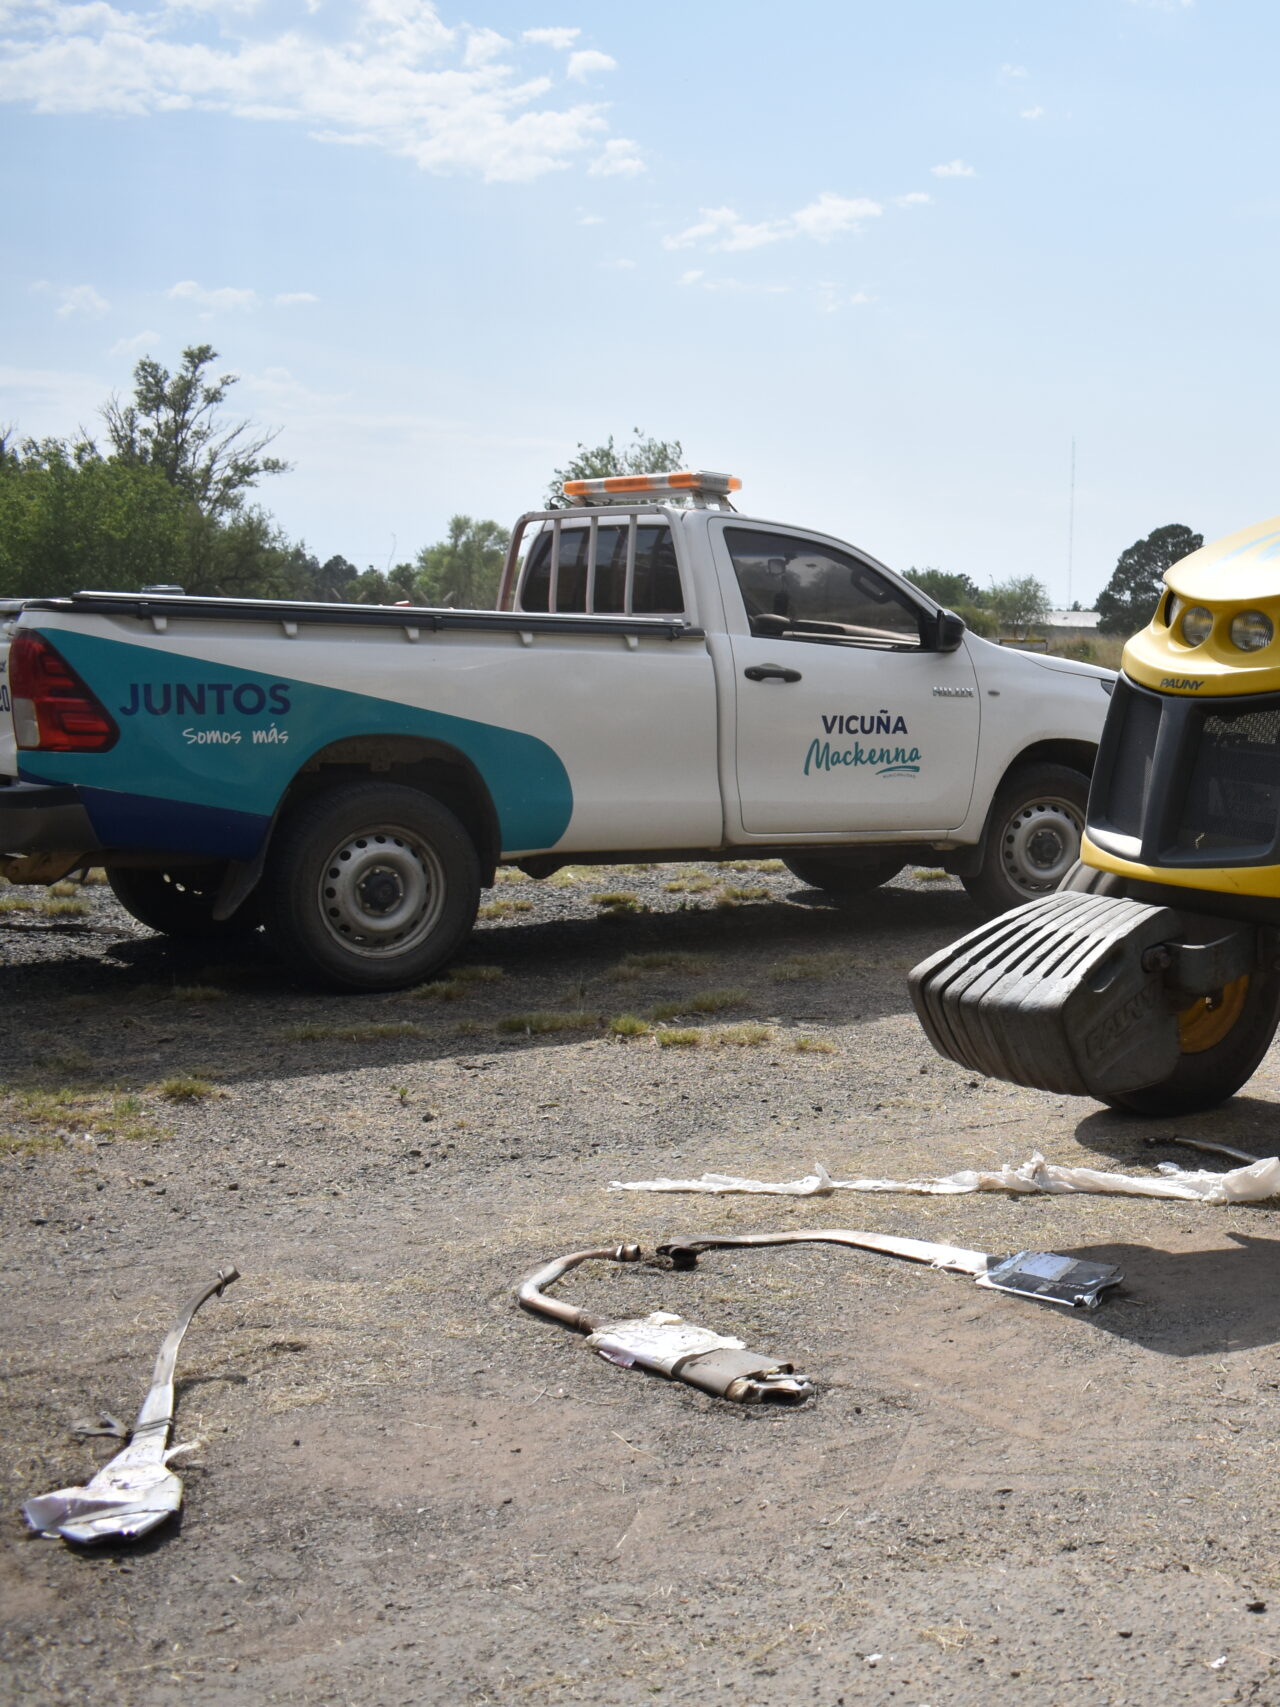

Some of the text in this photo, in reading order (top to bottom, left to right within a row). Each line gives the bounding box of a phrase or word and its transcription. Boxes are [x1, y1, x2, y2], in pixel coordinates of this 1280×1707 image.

[932, 686, 974, 698] HILUX
[1160, 678, 1205, 690] PAUNY
[119, 683, 291, 716] JUNTOS
[182, 722, 289, 744] Somos más
[821, 709, 908, 735] VICUÑA
[803, 738, 922, 776] Mackenna
